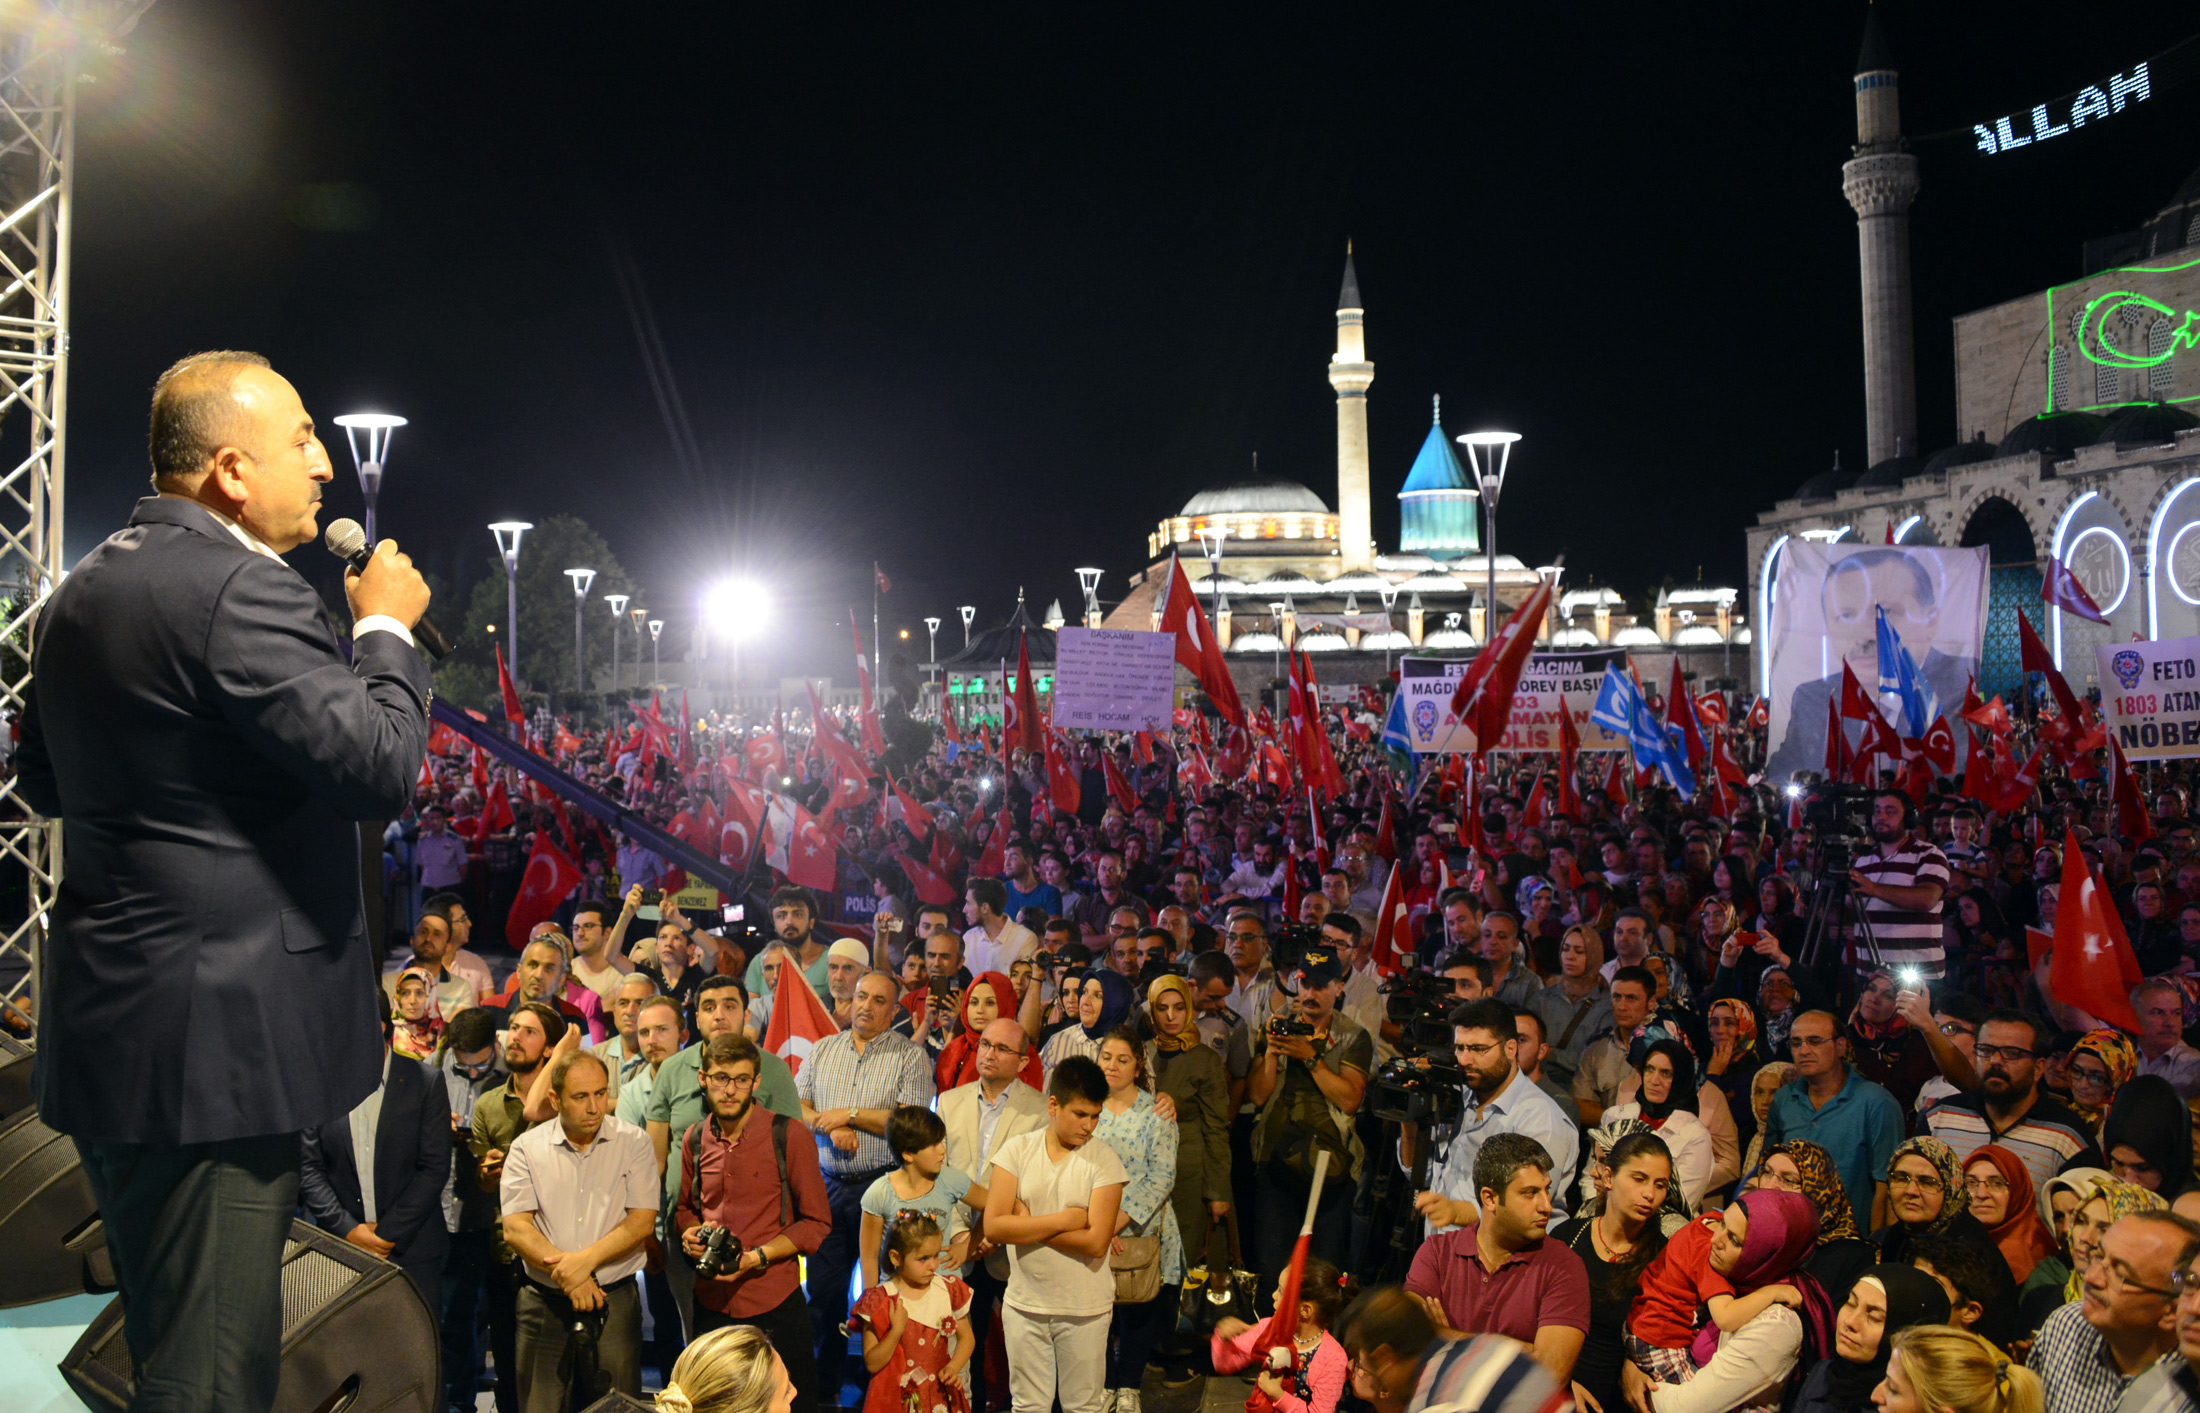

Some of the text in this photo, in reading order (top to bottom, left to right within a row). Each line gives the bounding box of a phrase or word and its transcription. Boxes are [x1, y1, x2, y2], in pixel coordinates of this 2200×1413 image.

[1444, 664, 1470, 677] FET
[2153, 658, 2196, 681] FETO
[1563, 678, 1602, 695] BAŞI
[2115, 694, 2158, 716] 1803
[1499, 725, 1550, 748] OLİS
[845, 895, 876, 912] POLİS
